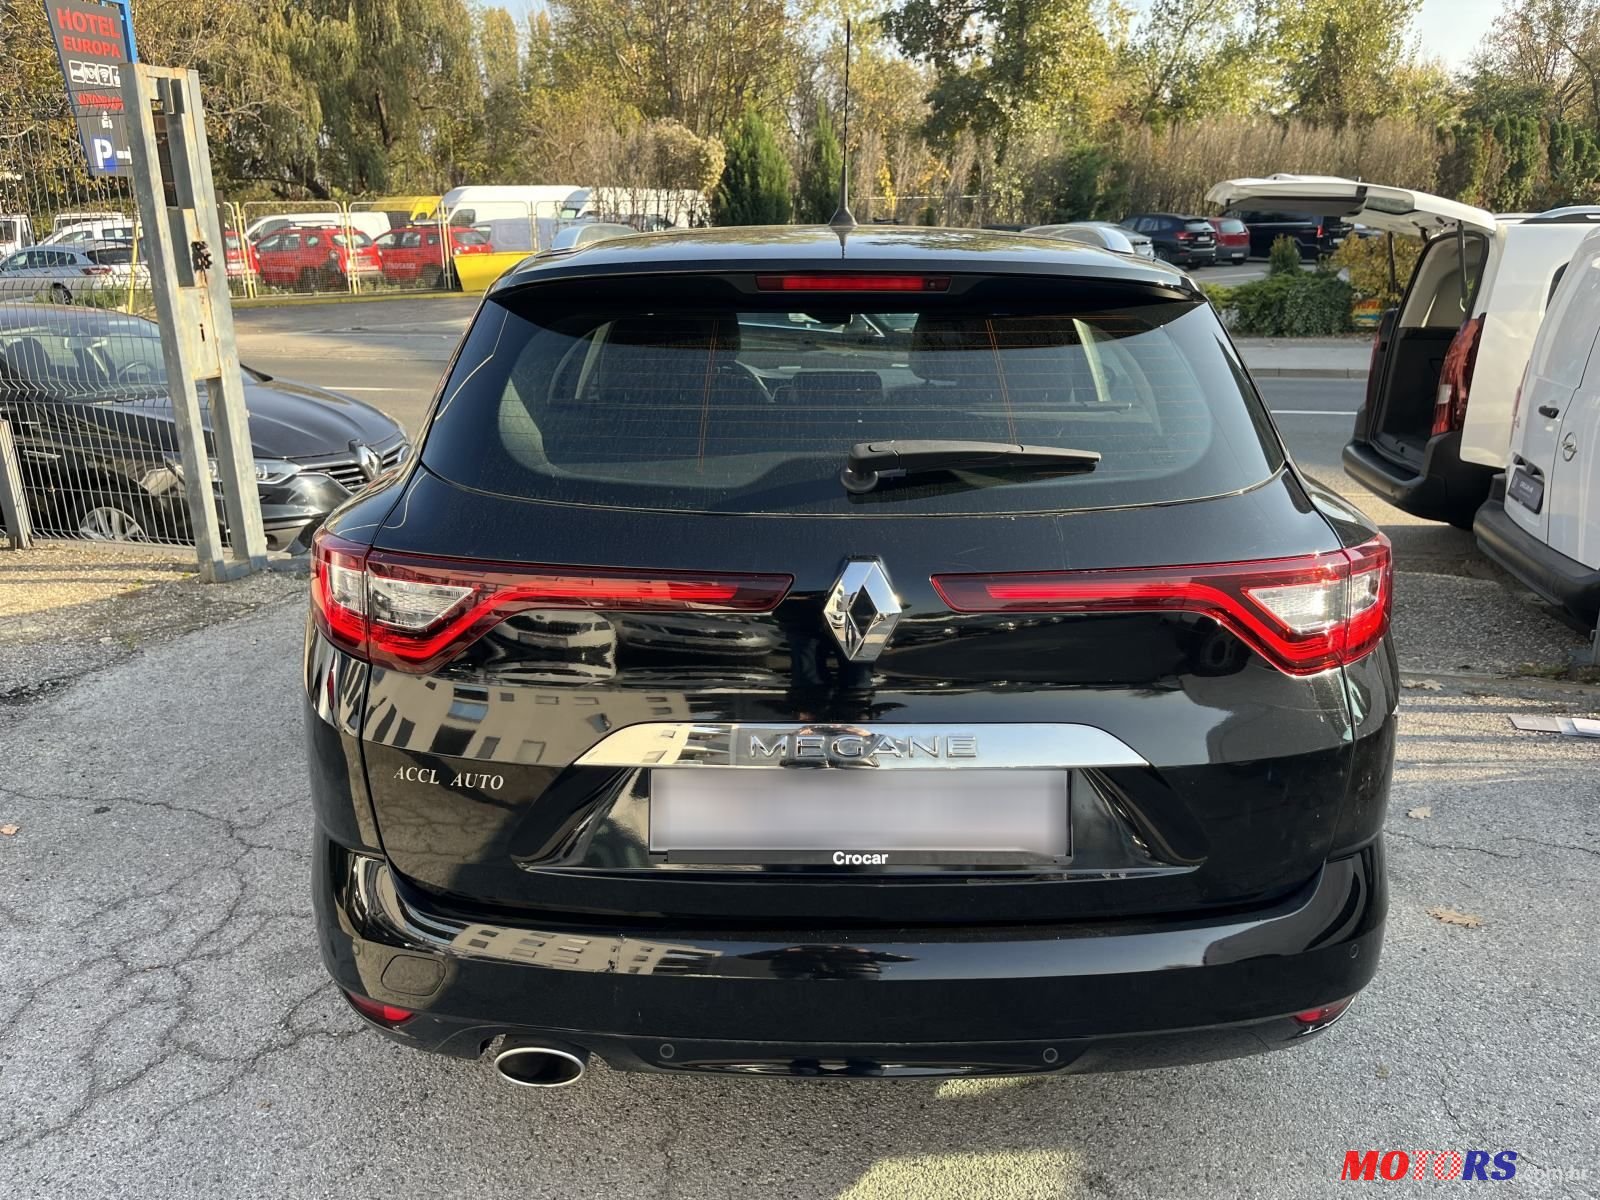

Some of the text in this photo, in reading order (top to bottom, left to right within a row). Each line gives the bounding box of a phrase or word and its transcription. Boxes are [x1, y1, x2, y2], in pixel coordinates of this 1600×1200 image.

[56, 8, 121, 39] HOTEL
[62, 35, 121, 59] EUROPA
[94, 138, 113, 169] P
[750, 735, 977, 758] MEGANE
[393, 766, 505, 790] ACCL AUTO
[832, 851, 889, 865] Crocar
